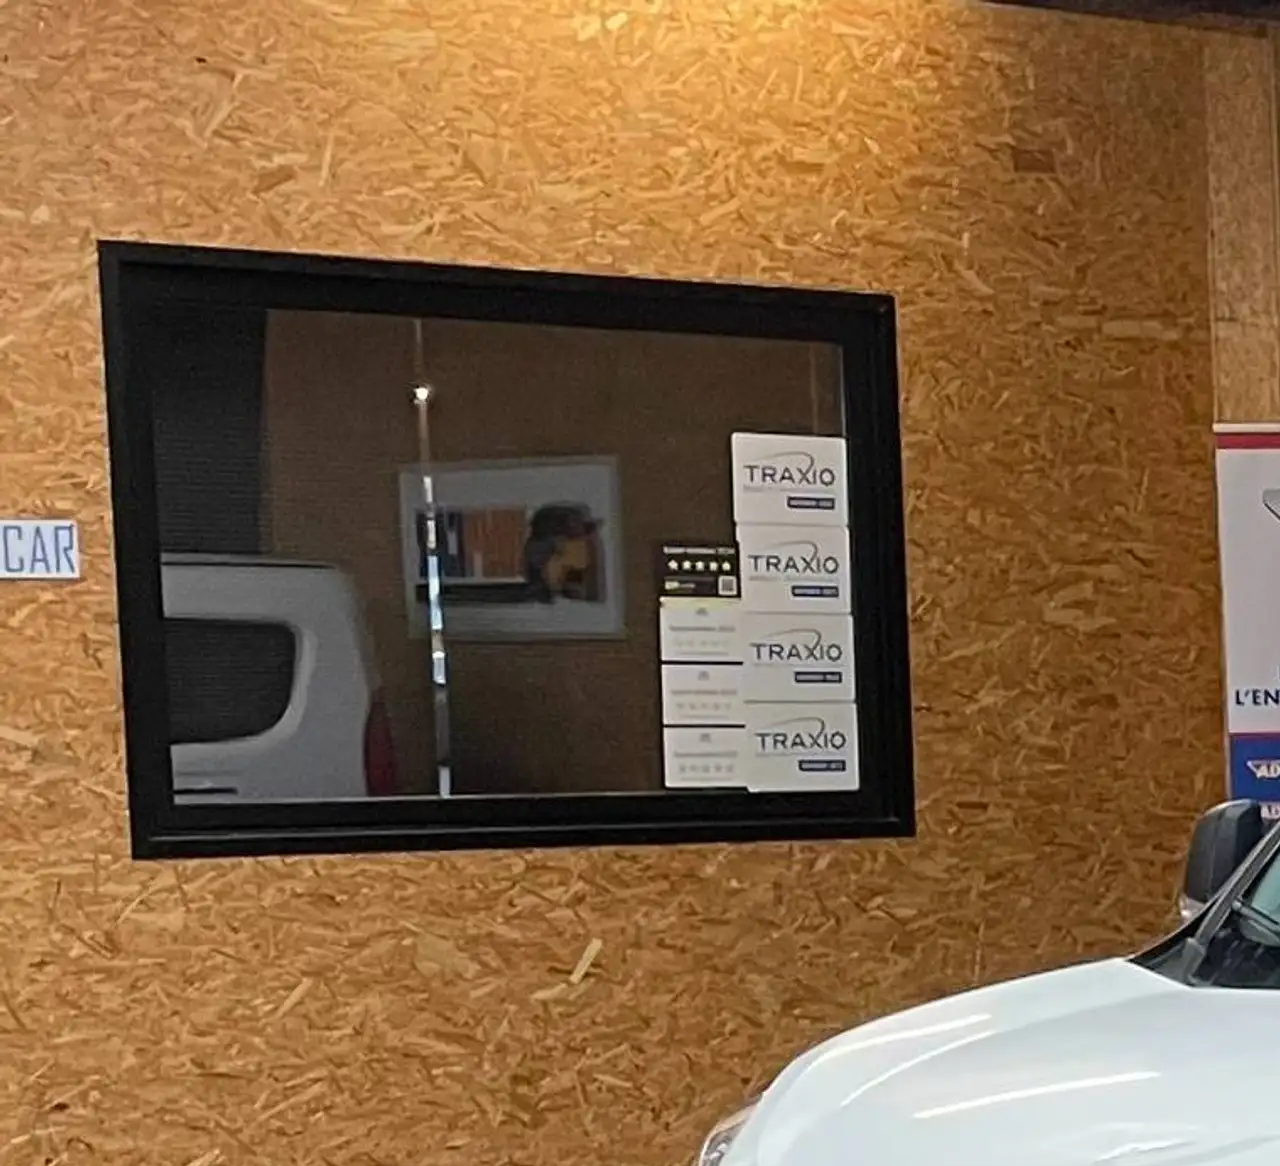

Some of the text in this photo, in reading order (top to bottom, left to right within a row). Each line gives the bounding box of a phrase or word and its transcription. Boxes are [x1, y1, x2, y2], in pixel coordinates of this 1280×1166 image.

[743, 461, 836, 487] TRAXIO
[3, 525, 76, 574] CAR
[747, 551, 839, 575] TRAXIO
[749, 640, 843, 662] TRAXIO
[754, 728, 847, 750] TRAXIO
